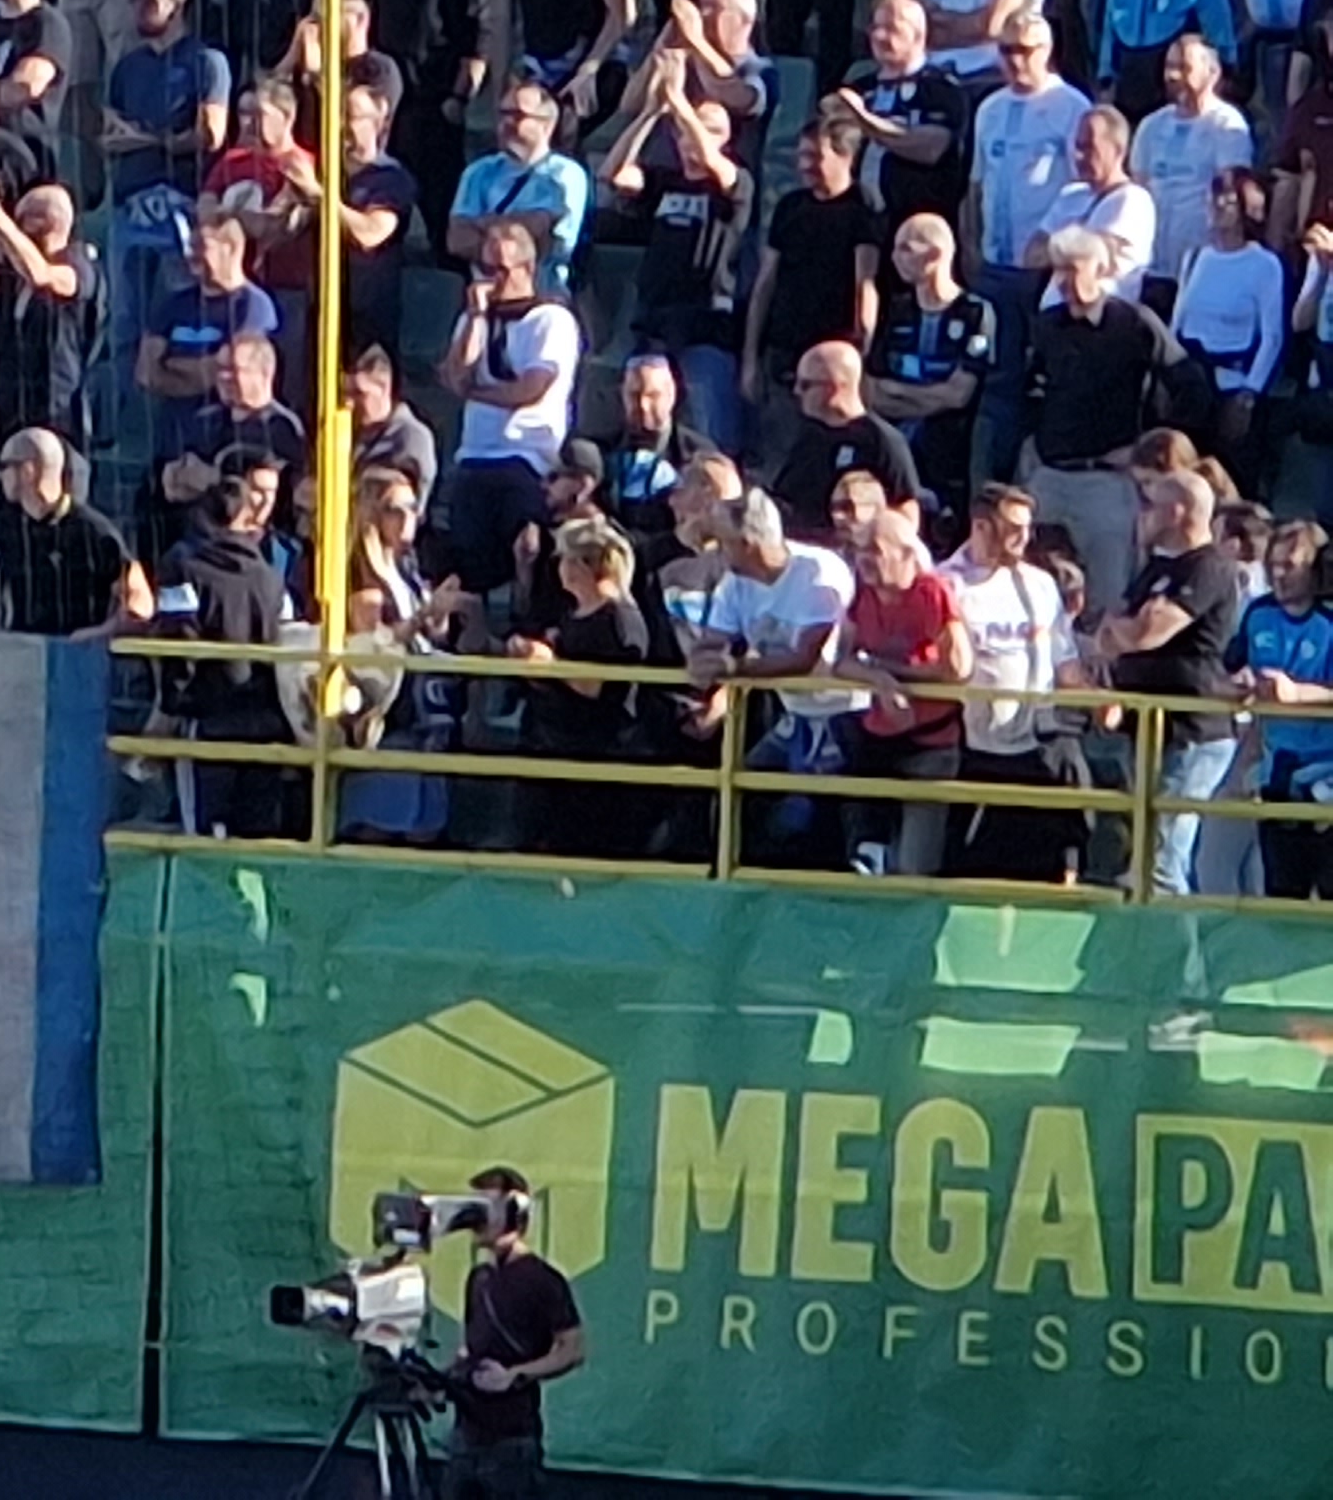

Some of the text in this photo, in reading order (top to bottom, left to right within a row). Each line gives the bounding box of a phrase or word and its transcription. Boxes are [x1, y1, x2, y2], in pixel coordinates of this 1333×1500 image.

[649, 1083, 1333, 1299] MEGA PA
[644, 1289, 1333, 1390] PROFESSIO
